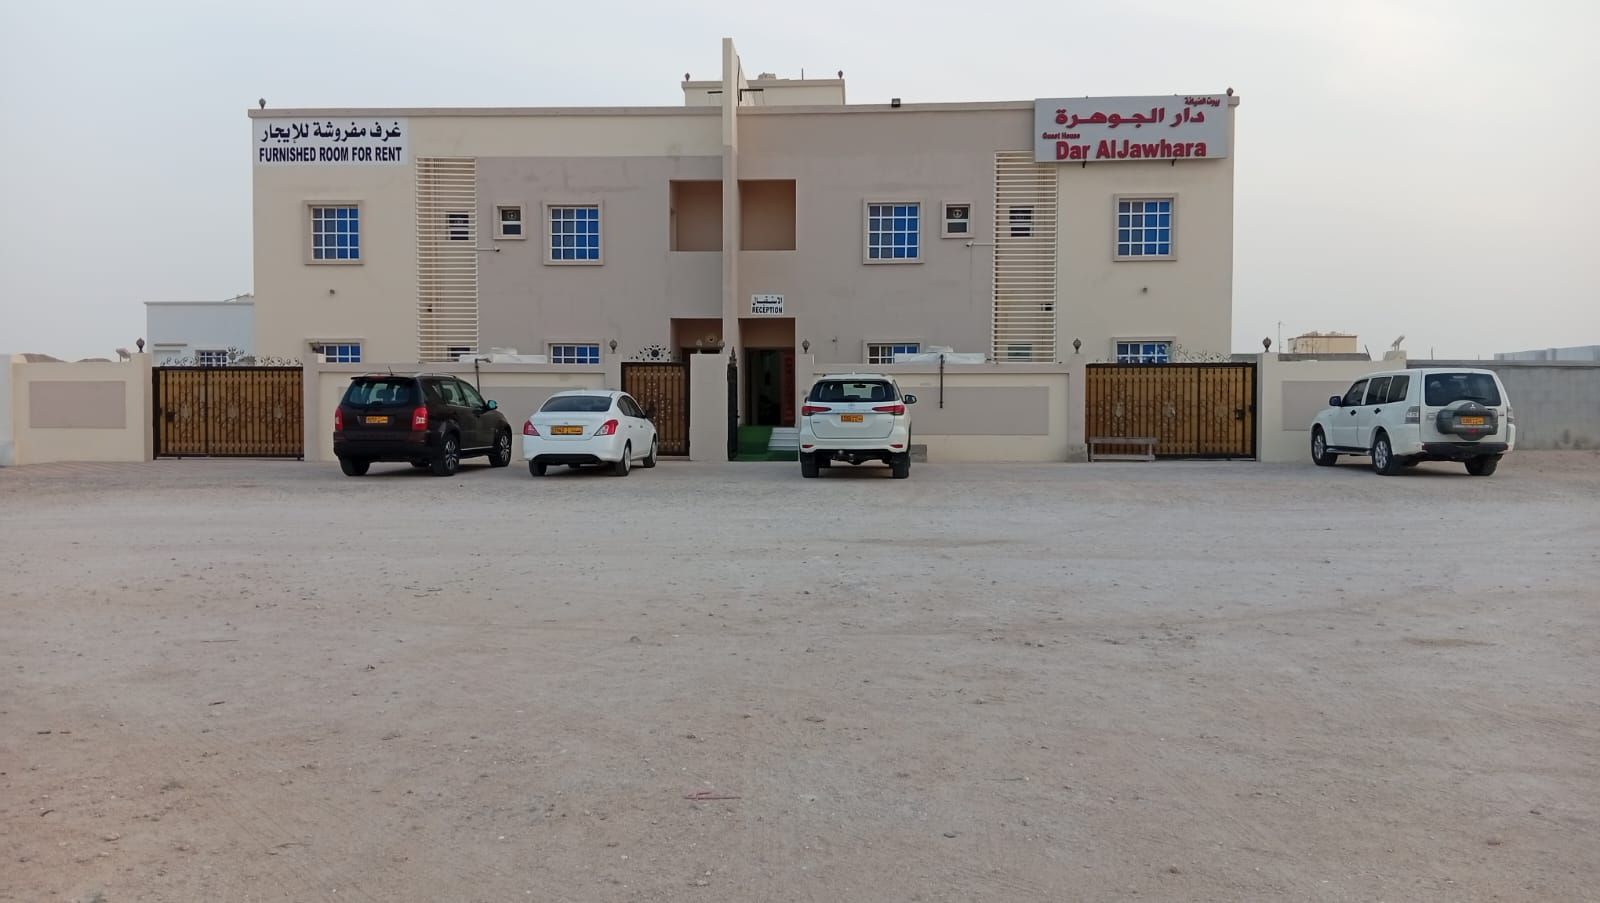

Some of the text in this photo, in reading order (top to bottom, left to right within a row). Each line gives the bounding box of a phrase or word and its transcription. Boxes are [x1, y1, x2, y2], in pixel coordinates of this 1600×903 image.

[1055, 107, 1204, 129] دار الجوهرة
[261, 121, 401, 143] غرف مفروشة للإيجار
[259, 147, 402, 162] FURNISHED ROOM FOR RENT
[1056, 139, 1207, 160] Dar AlJawhara
